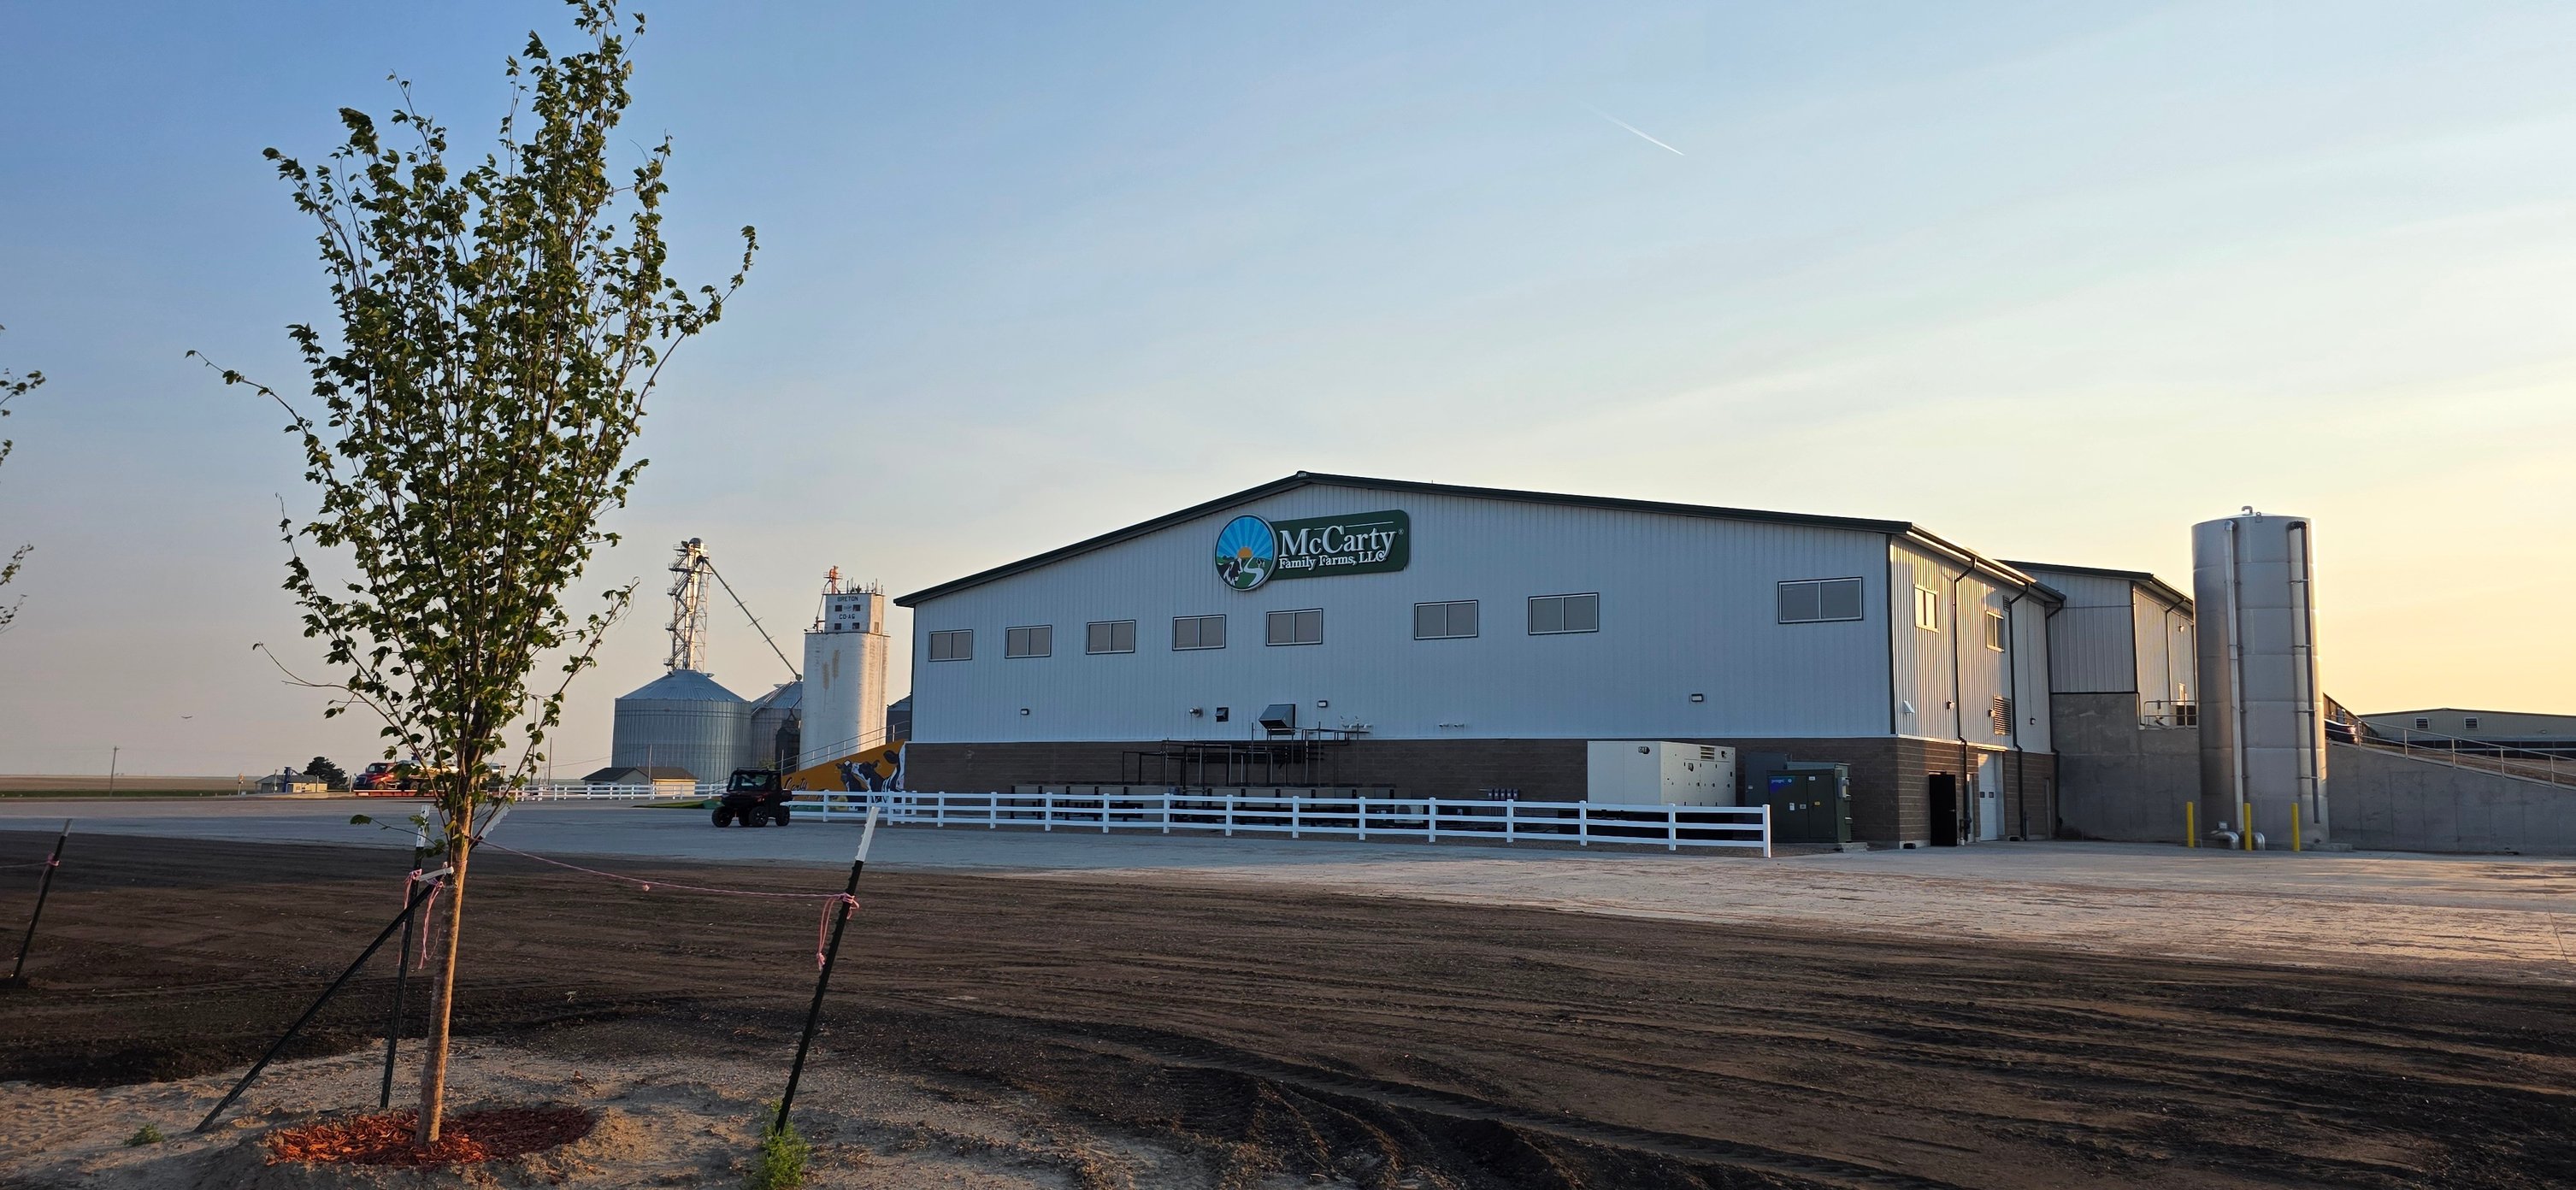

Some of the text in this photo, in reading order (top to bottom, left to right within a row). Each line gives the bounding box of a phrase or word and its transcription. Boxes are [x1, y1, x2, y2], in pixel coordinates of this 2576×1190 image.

[1278, 525, 1397, 558] McCarty
[1278, 550, 1387, 571] Family Farms, LLC
